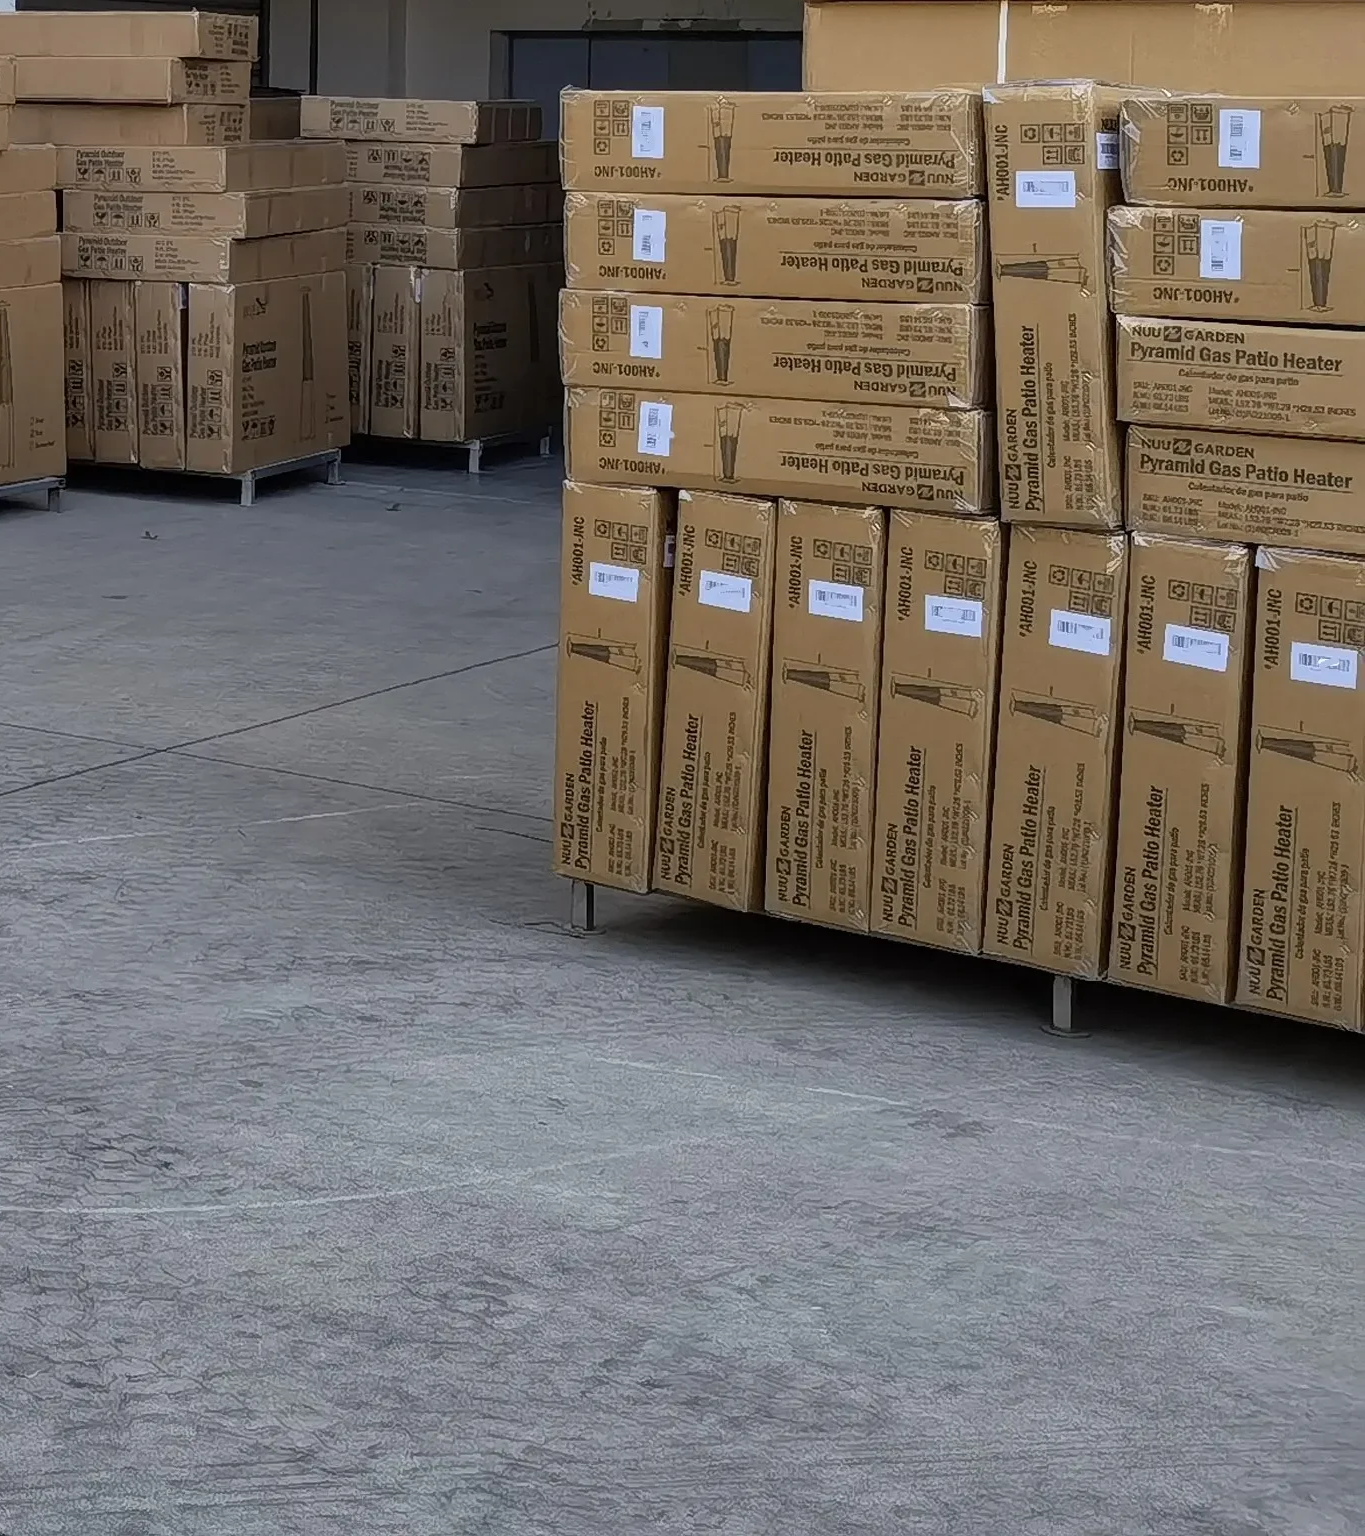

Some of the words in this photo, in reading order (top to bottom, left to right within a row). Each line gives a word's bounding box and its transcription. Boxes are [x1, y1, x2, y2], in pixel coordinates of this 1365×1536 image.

[774, 150, 821, 164] Heater
[825, 151, 861, 166] Patio
[865, 152, 894, 165] Gas
[898, 151, 955, 168] Pyramid
[854, 171, 907, 183] GARDEN
[926, 172, 954, 184] NUU
[781, 254, 828, 270] Heater
[831, 256, 868, 272] Patio
[872, 257, 901, 273] Gas
[906, 259, 963, 276] Pyramid
[861, 278, 914, 290] GARDEN
[935, 280, 963, 292] NUU
[1131, 325, 1161, 337] NUU
[1184, 327, 1244, 344] GARDEN
[1019, 325, 1035, 375] Heater
[1130, 341, 1195, 362] Pyramid
[1200, 348, 1231, 363] Gas
[1236, 350, 1278, 368] Patio
[1283, 354, 1342, 372] Heater
[773, 356, 820, 373] Heater
[824, 359, 860, 375] Patio
[864, 361, 893, 377] Gas
[898, 362, 956, 381] Pyramid
[854, 381, 907, 393] GARDEN
[1020, 380, 1037, 417] Patio
[1005, 409, 1019, 461] GARDEN
[1022, 421, 1038, 448] Gas
[1141, 438, 1171, 450] NUU
[1195, 441, 1254, 458] GARDEN
[781, 456, 827, 474] Heater
[831, 460, 867, 477] Patio
[870, 463, 900, 480] Gas
[906, 464, 964, 485] Pyramid
[1140, 454, 1205, 474] Pyramid
[1210, 460, 1241, 477] Gas
[1246, 465, 1288, 481] Patio
[1293, 470, 1353, 489] Heater
[861, 482, 914, 496] GARDEN
[1022, 453, 1041, 511] Pyramid
[1007, 483, 1020, 509] NUU
[580, 701, 595, 747] Heater
[579, 750, 593, 785] Patio
[564, 773, 575, 822] GARDEN
[578, 788, 591, 814] Gas
[1274, 806, 1293, 858] Heater
[562, 840, 573, 865] NUU
[575, 817, 593, 870] Pyramid
[1273, 862, 1289, 901] Patio
[1251, 889, 1266, 946] GARDEN
[1270, 905, 1287, 935] Gas
[1266, 939, 1288, 1001] Pyramid
[1248, 967, 1262, 995] NUU
